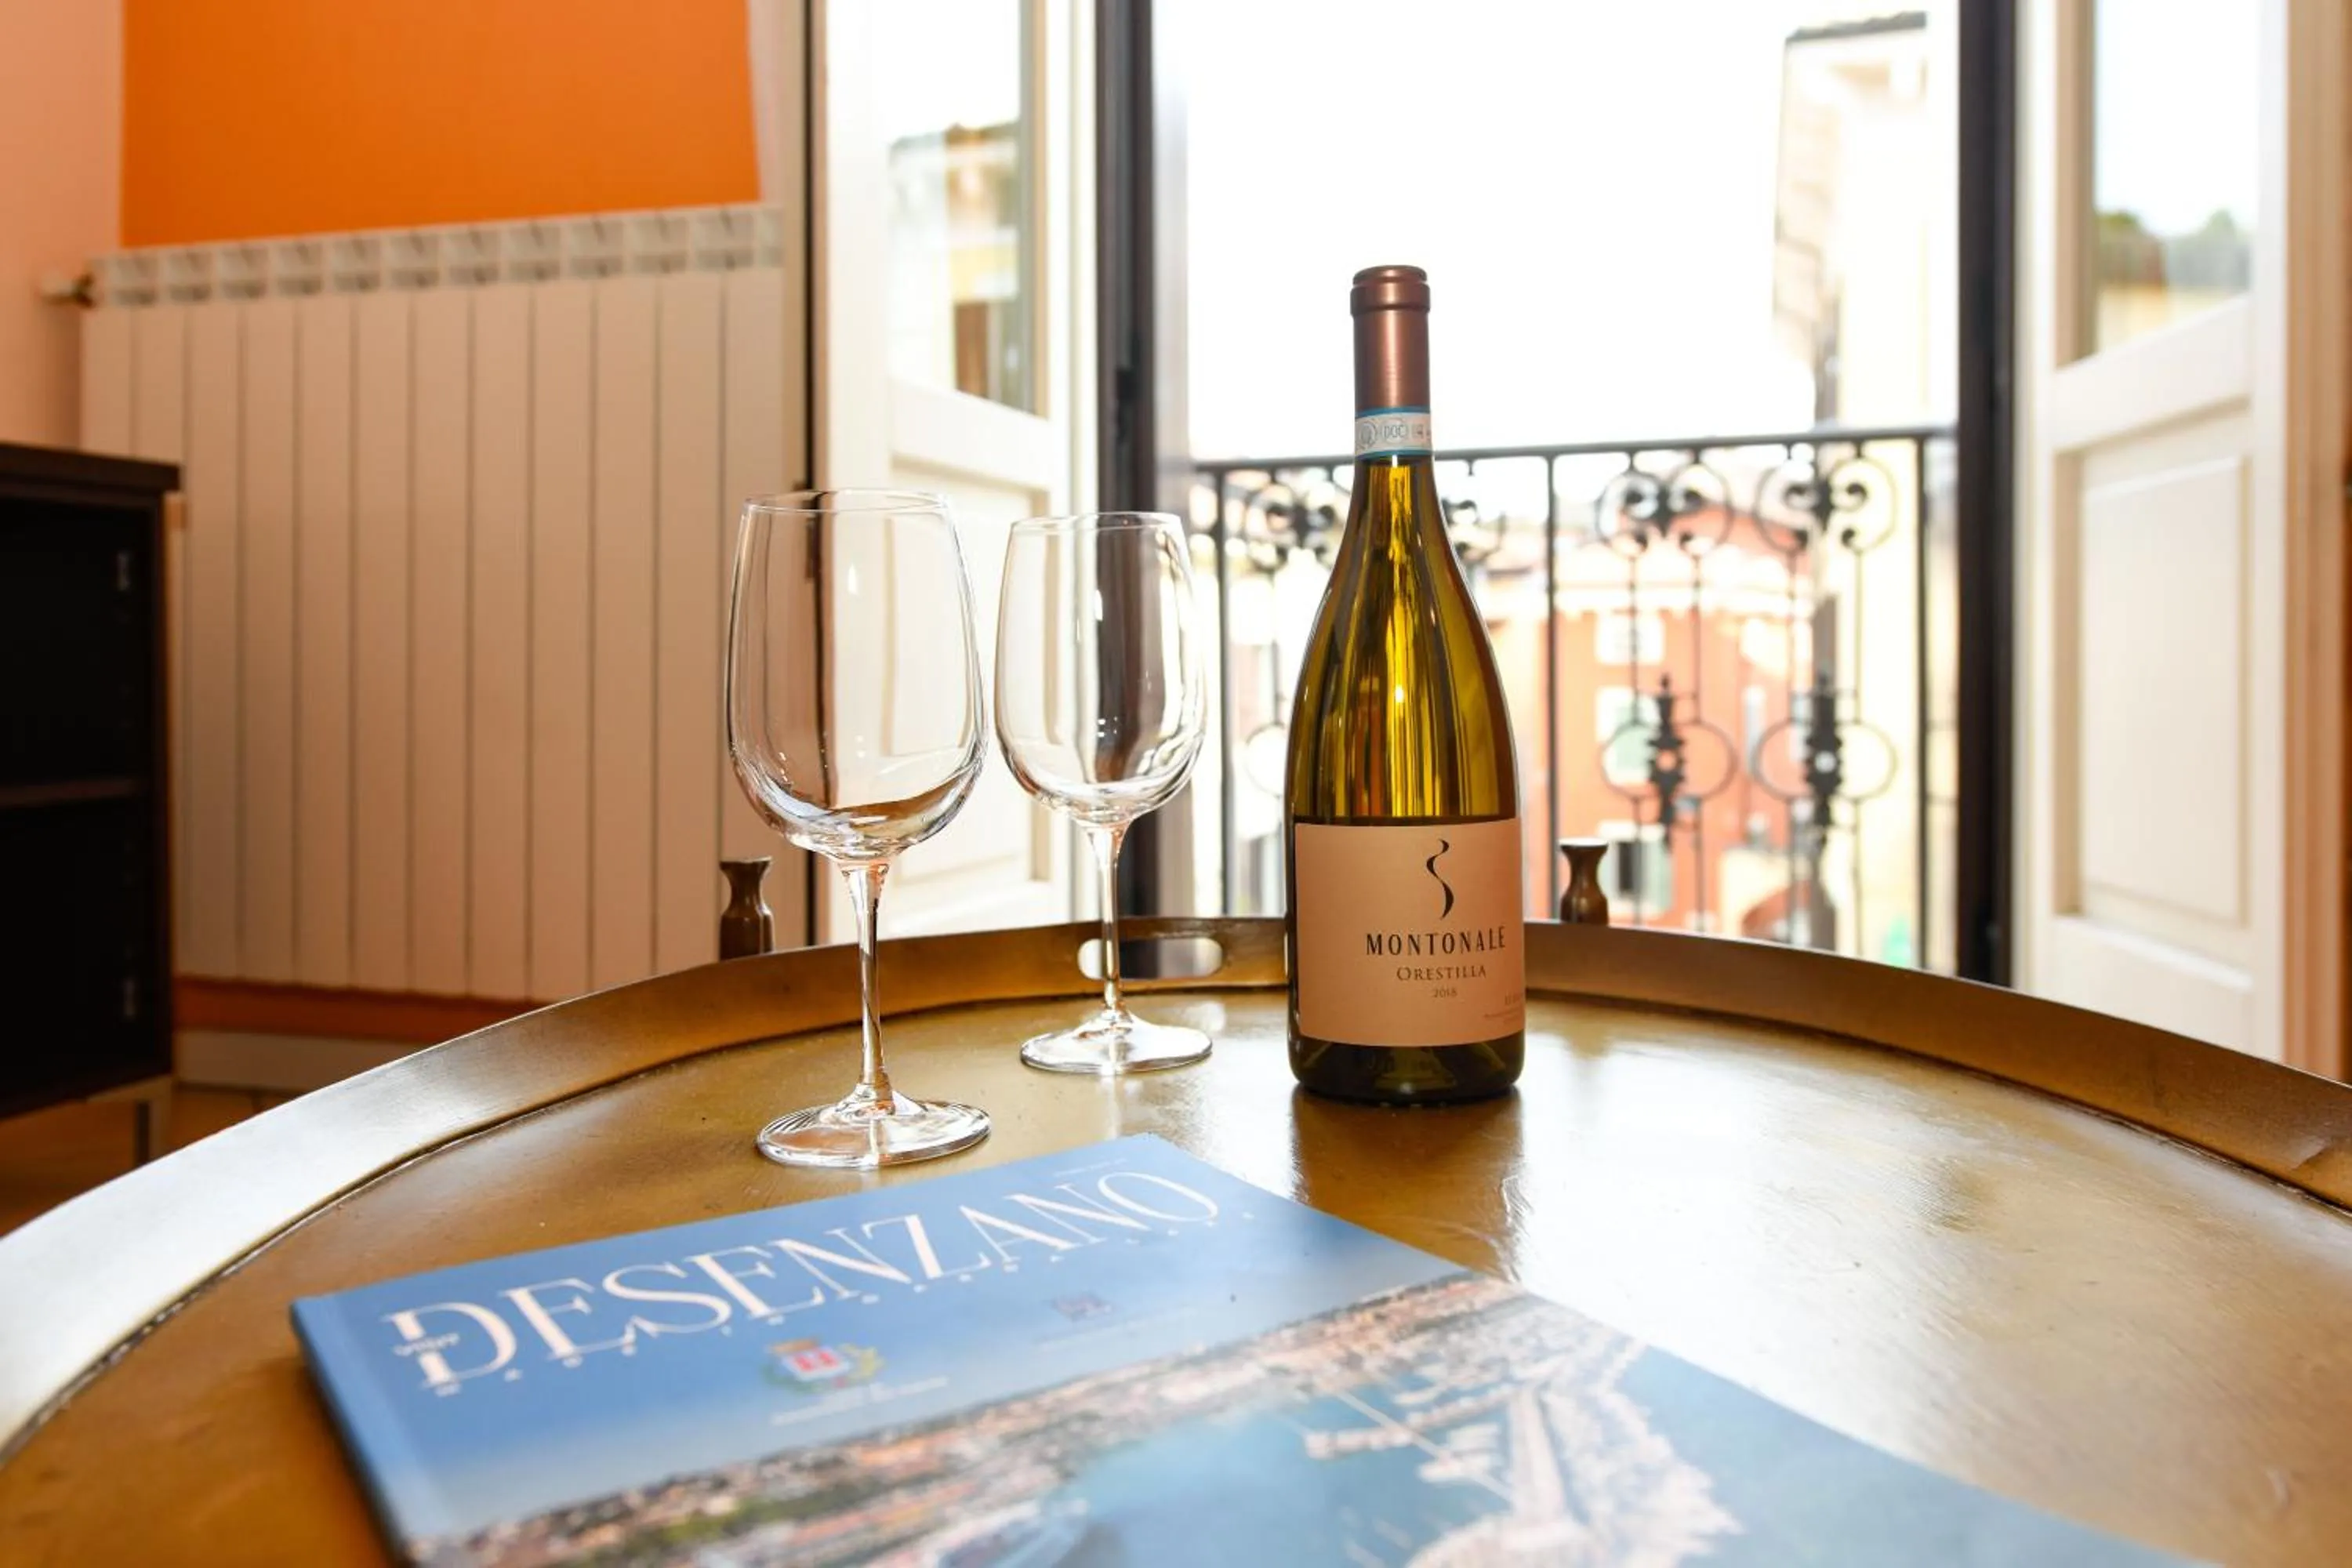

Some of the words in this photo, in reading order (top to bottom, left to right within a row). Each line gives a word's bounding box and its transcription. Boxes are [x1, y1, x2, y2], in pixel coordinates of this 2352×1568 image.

[1366, 926, 1506, 956] MONTONALE
[1396, 965, 1486, 981] ORESTILLA
[382, 1171, 1218, 1389] DESENZANO
